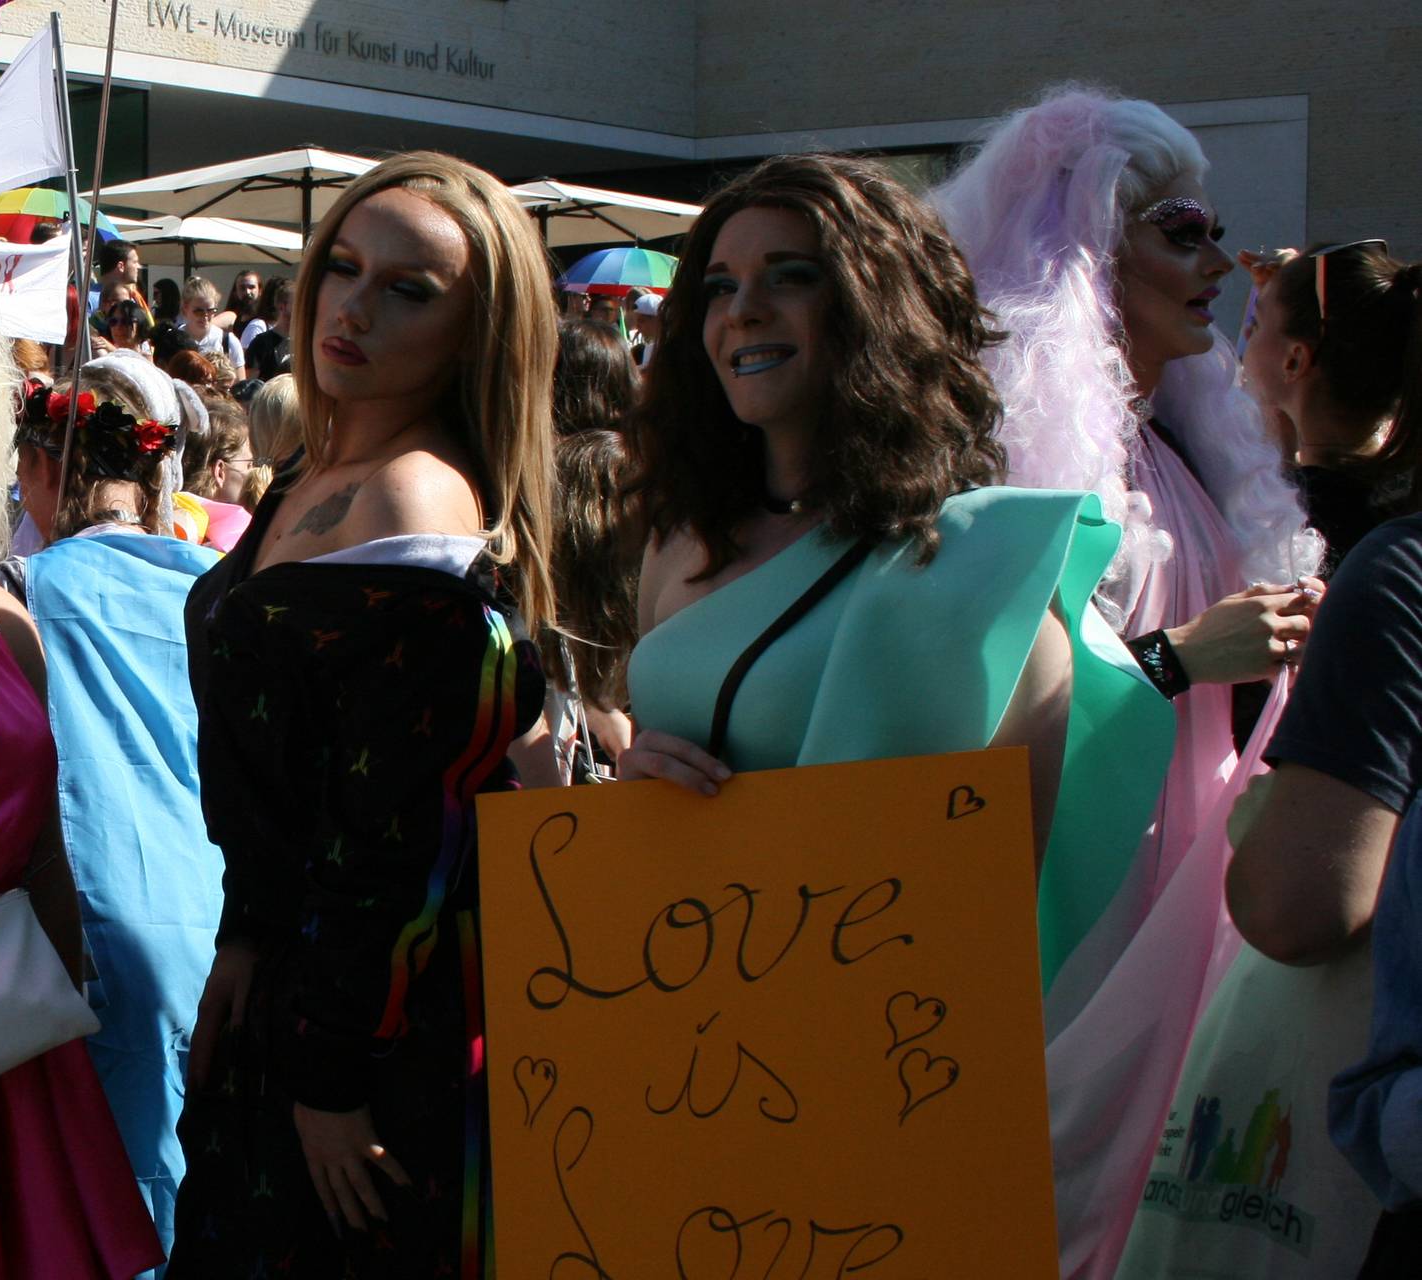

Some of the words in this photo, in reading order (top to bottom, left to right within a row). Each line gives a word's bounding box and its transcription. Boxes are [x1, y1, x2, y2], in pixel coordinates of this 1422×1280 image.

[315, 22, 341, 53] für
[347, 30, 397, 64] Kunst
[404, 43, 439, 71] und
[446, 47, 497, 80] Kultur
[526, 811, 914, 1010] Love
[645, 1011, 799, 1124] is
